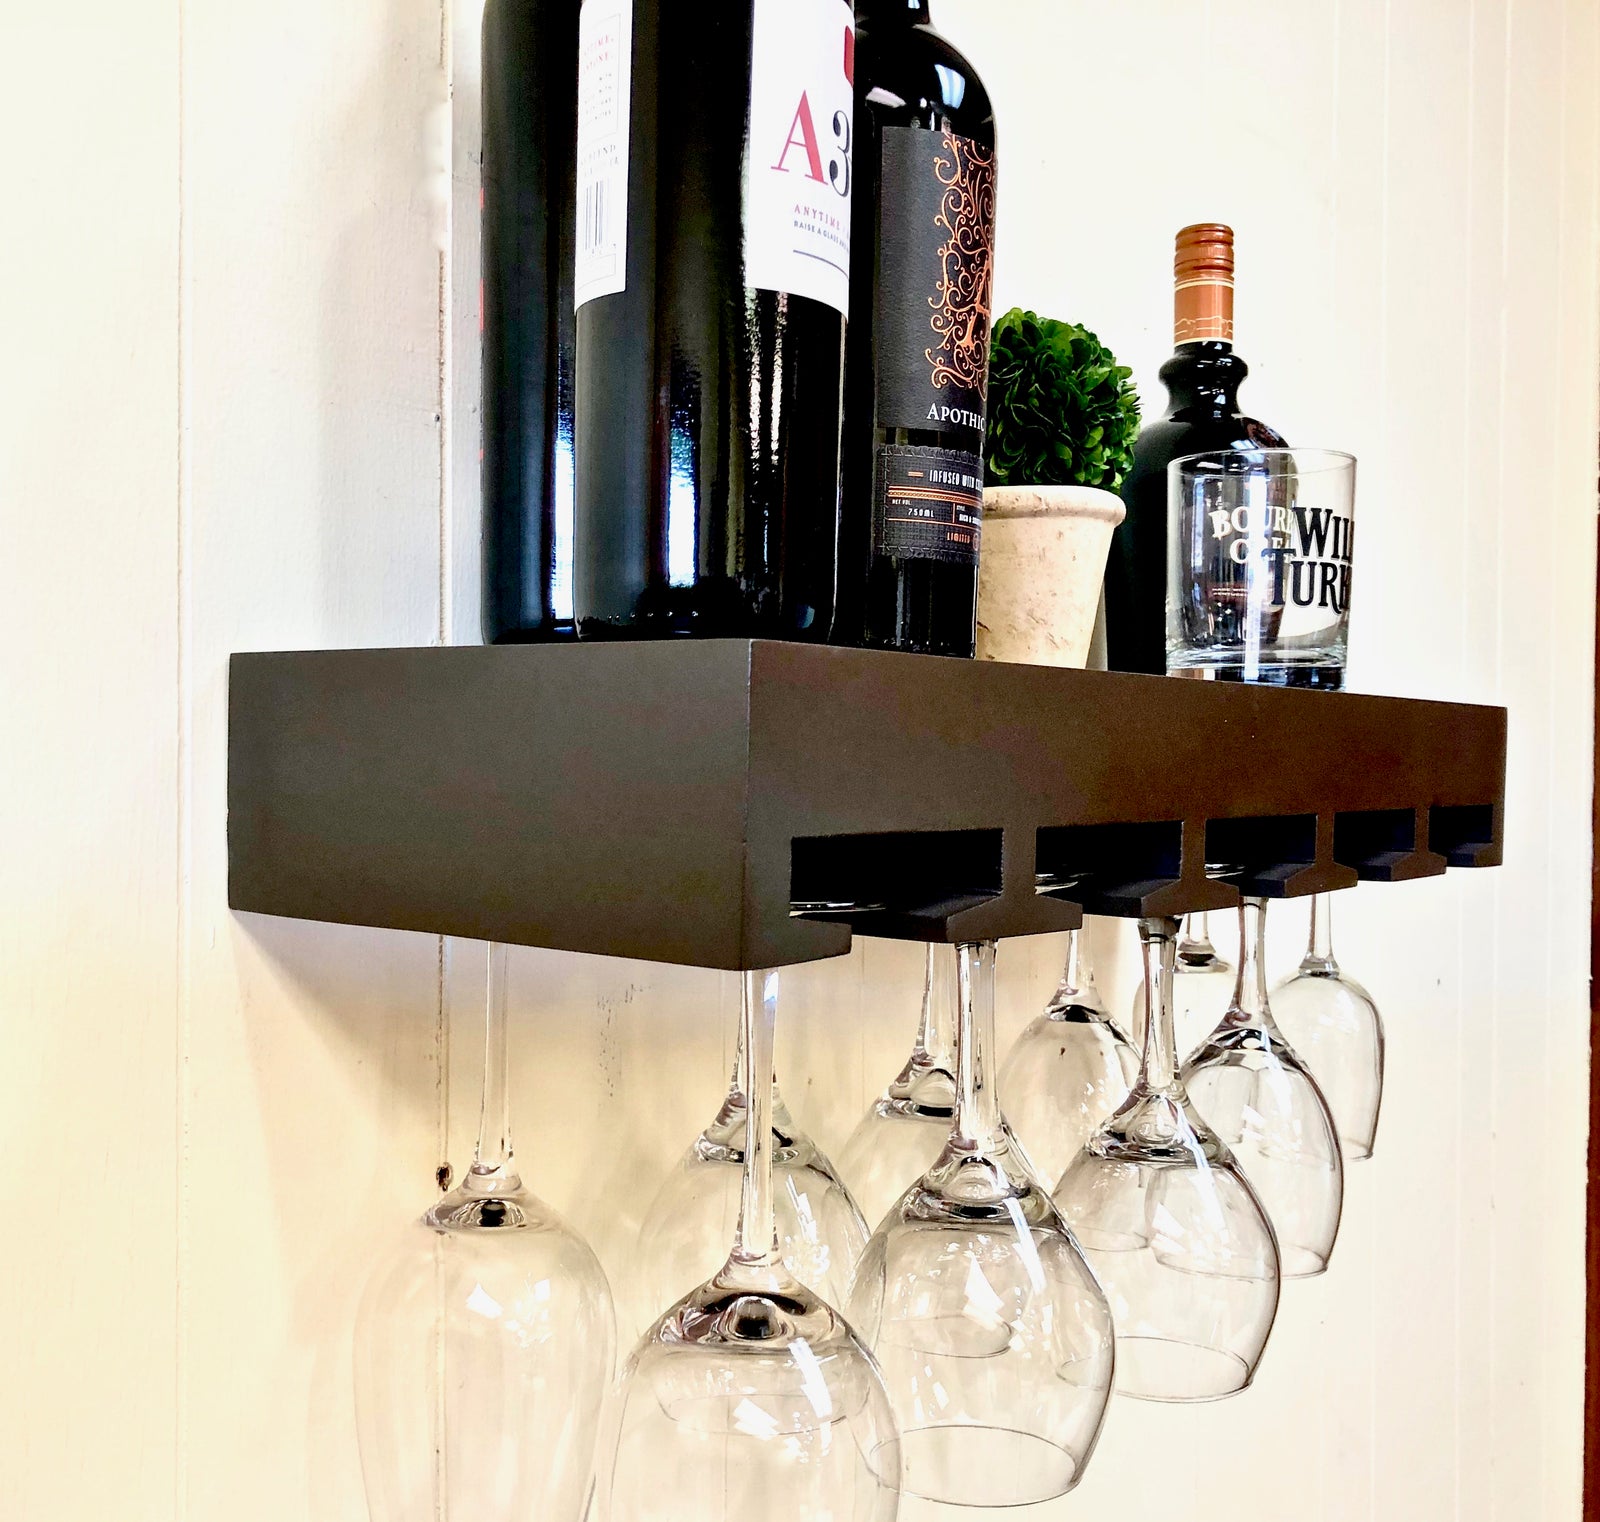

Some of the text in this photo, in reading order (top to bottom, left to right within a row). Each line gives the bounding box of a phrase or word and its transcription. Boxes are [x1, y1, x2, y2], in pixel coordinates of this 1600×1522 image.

[926, 402, 985, 432] APOTHIC
[929, 470, 960, 486] INFUSED
[908, 508, 935, 517] 750ML
[1291, 506, 1355, 562] WIL
